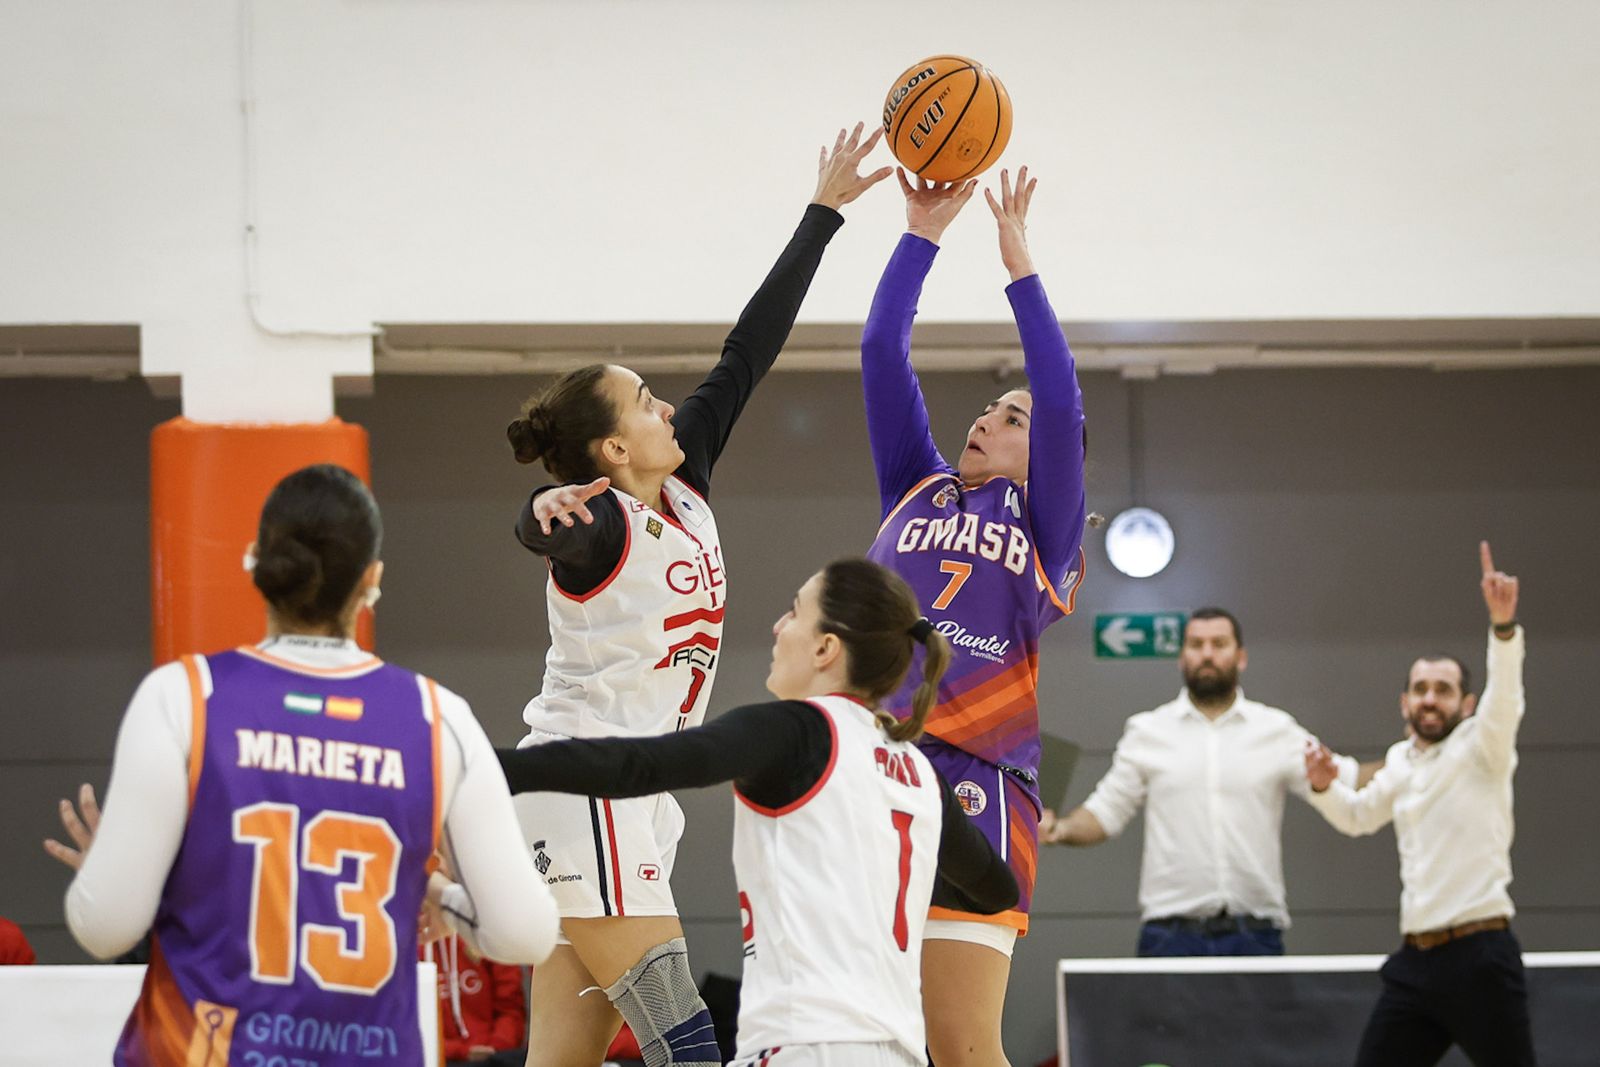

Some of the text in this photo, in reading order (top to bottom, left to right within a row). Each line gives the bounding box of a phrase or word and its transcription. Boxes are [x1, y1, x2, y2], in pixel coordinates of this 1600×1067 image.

[909, 98, 946, 150] EVO
[896, 512, 1030, 576] GMASB
[931, 559, 973, 610] 7
[936, 620, 1010, 656] Plantel
[970, 648, 1005, 665] Semilleros
[235, 729, 405, 789] MARIETA
[232, 801, 403, 996] 13
[548, 874, 582, 885] de Girona
